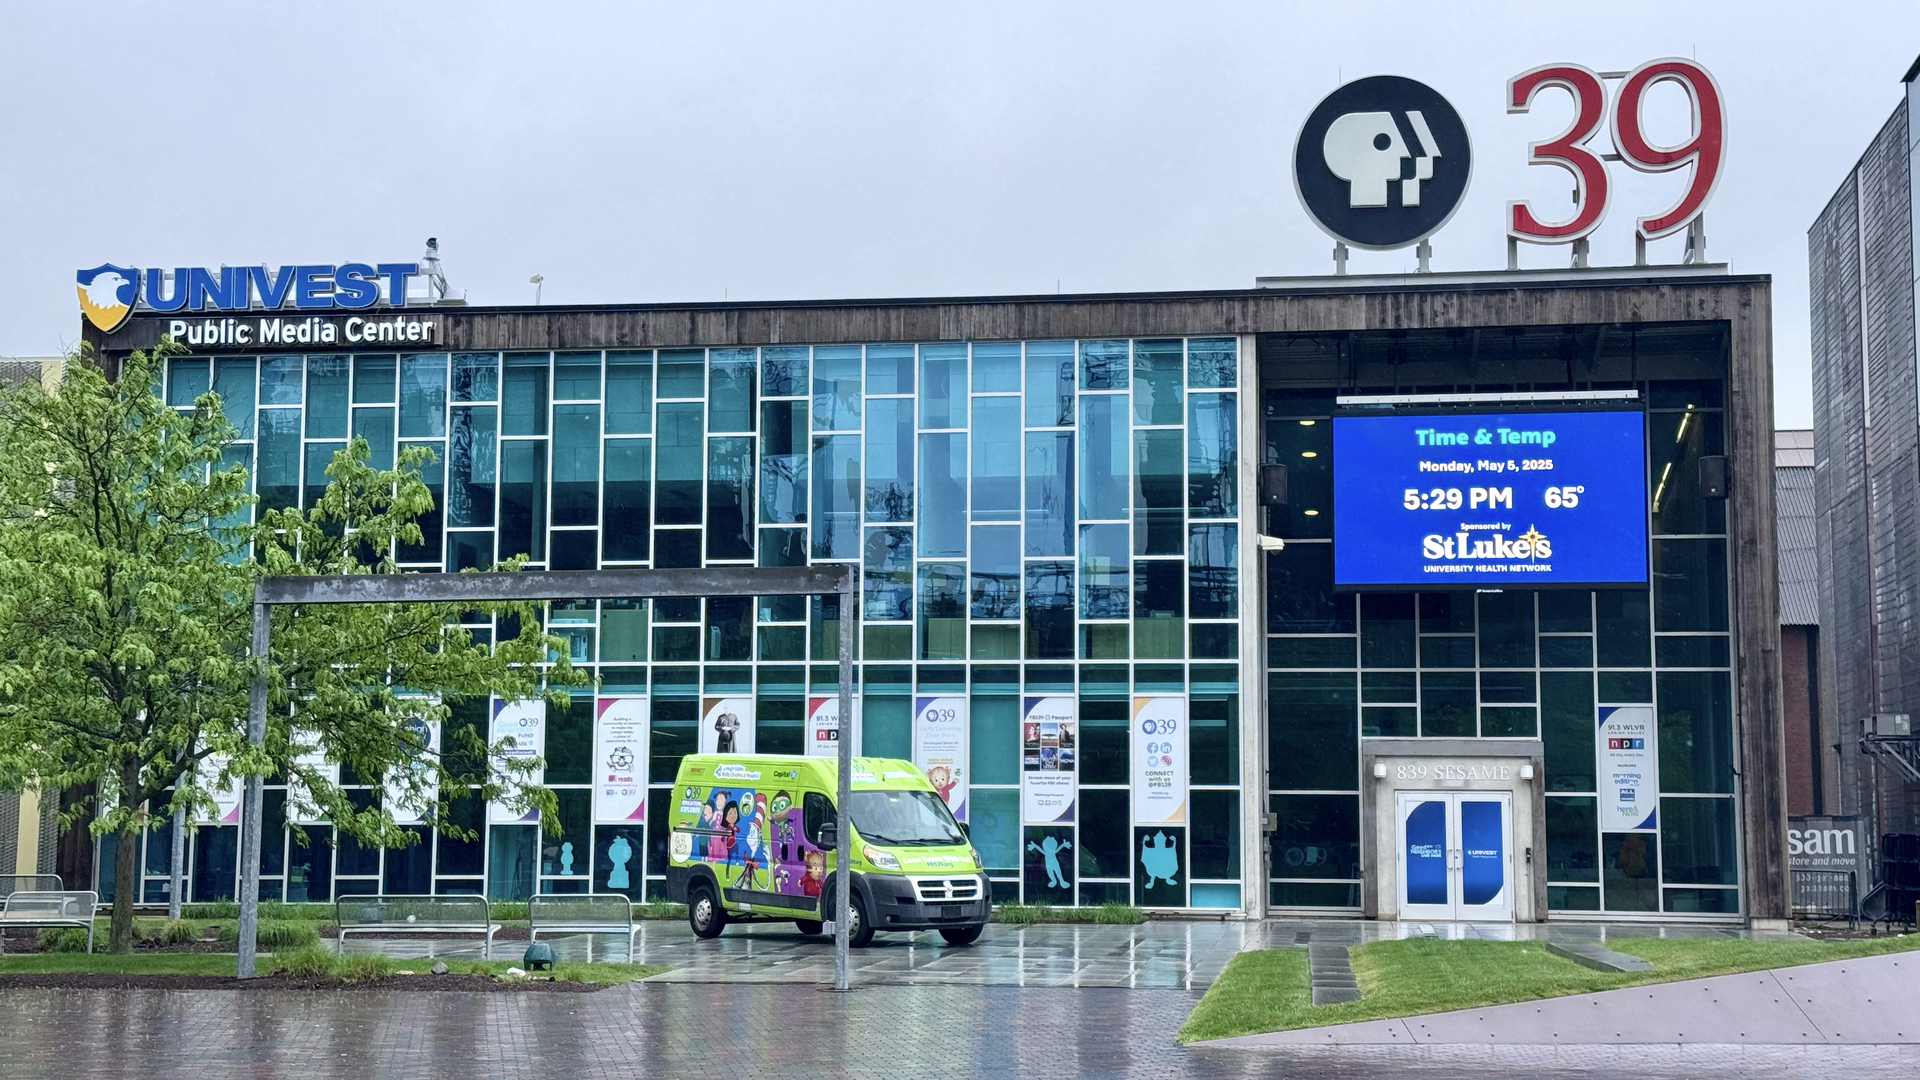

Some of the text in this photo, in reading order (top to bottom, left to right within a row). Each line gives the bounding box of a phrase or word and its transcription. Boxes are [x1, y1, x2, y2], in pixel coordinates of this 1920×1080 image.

[1507, 56, 1727, 245] 39
[145, 262, 418, 312] UNIVEST
[170, 316, 435, 345] Public Media Center
[1415, 428, 1556, 448] Time & Temp
[1419, 459, 1554, 473] Monday, May 5, 2025
[1403, 488, 1463, 510] 5:29
[1470, 487, 1513, 509] PM
[1460, 522, 1512, 531] Sponsored by
[1424, 565, 1474, 573] UNIVERSITY
[1510, 564, 1552, 572] NETWORK
[528, 718, 538, 727] 39
[939, 709, 955, 722] 39
[1157, 719, 1177, 735] 39
[1610, 739, 1642, 749] npr
[773, 770, 790, 778] Capital
[1397, 765, 1510, 780] 839 SESAME
[1788, 829, 1855, 855] sam
[1788, 857, 1809, 865] store
[1812, 857, 1829, 865] and
